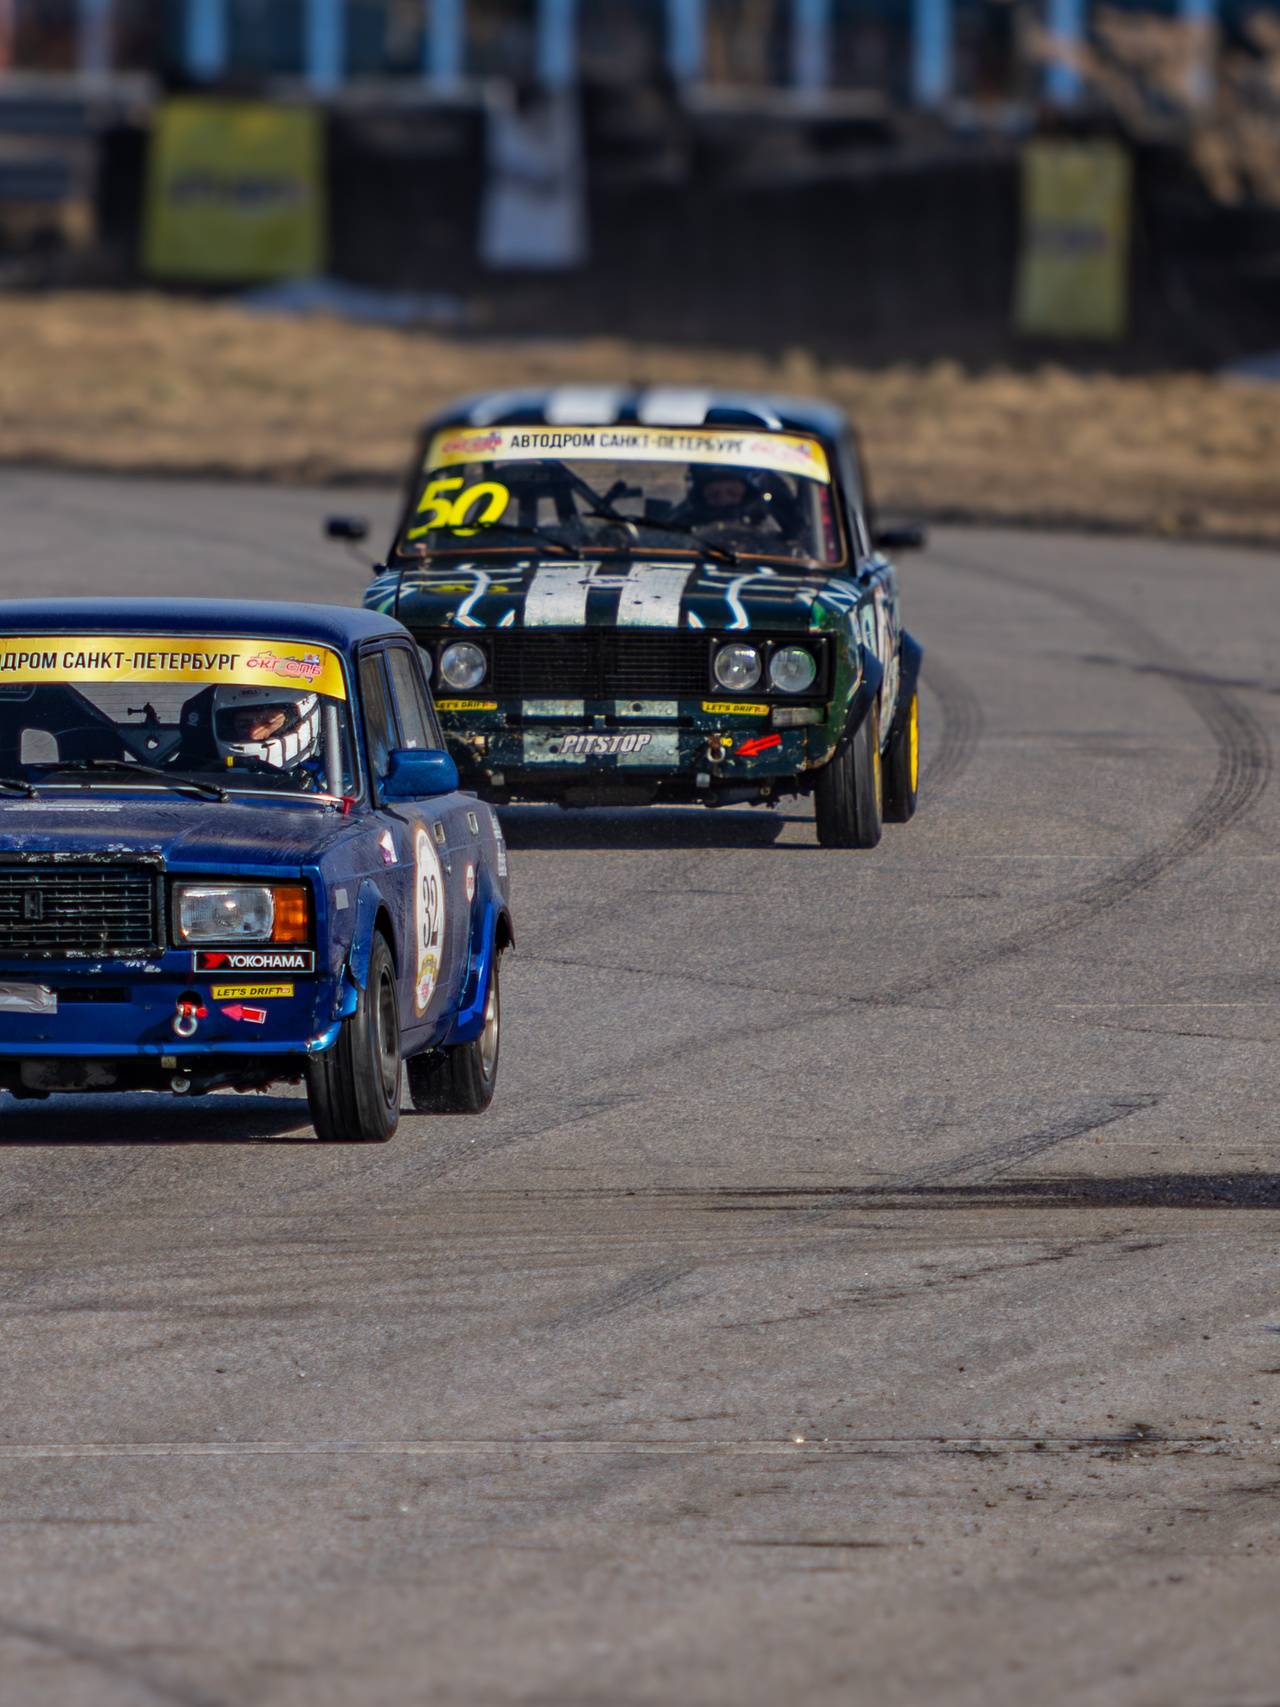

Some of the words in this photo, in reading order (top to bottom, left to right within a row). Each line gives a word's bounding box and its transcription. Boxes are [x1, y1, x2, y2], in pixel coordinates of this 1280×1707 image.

[510, 434, 595, 449] АВТОДРОМ
[600, 434, 744, 453] САНКТ-ПЕТЕРБУРГ
[407, 477, 510, 540] 50
[62, 651, 240, 671] САНКТ-ПЕТЕРБУРГ
[561, 733, 652, 755] PITSTOP
[423, 874, 439, 948] 32
[228, 955, 304, 967] YOKOHAMA
[217, 988, 246, 996] LET'S
